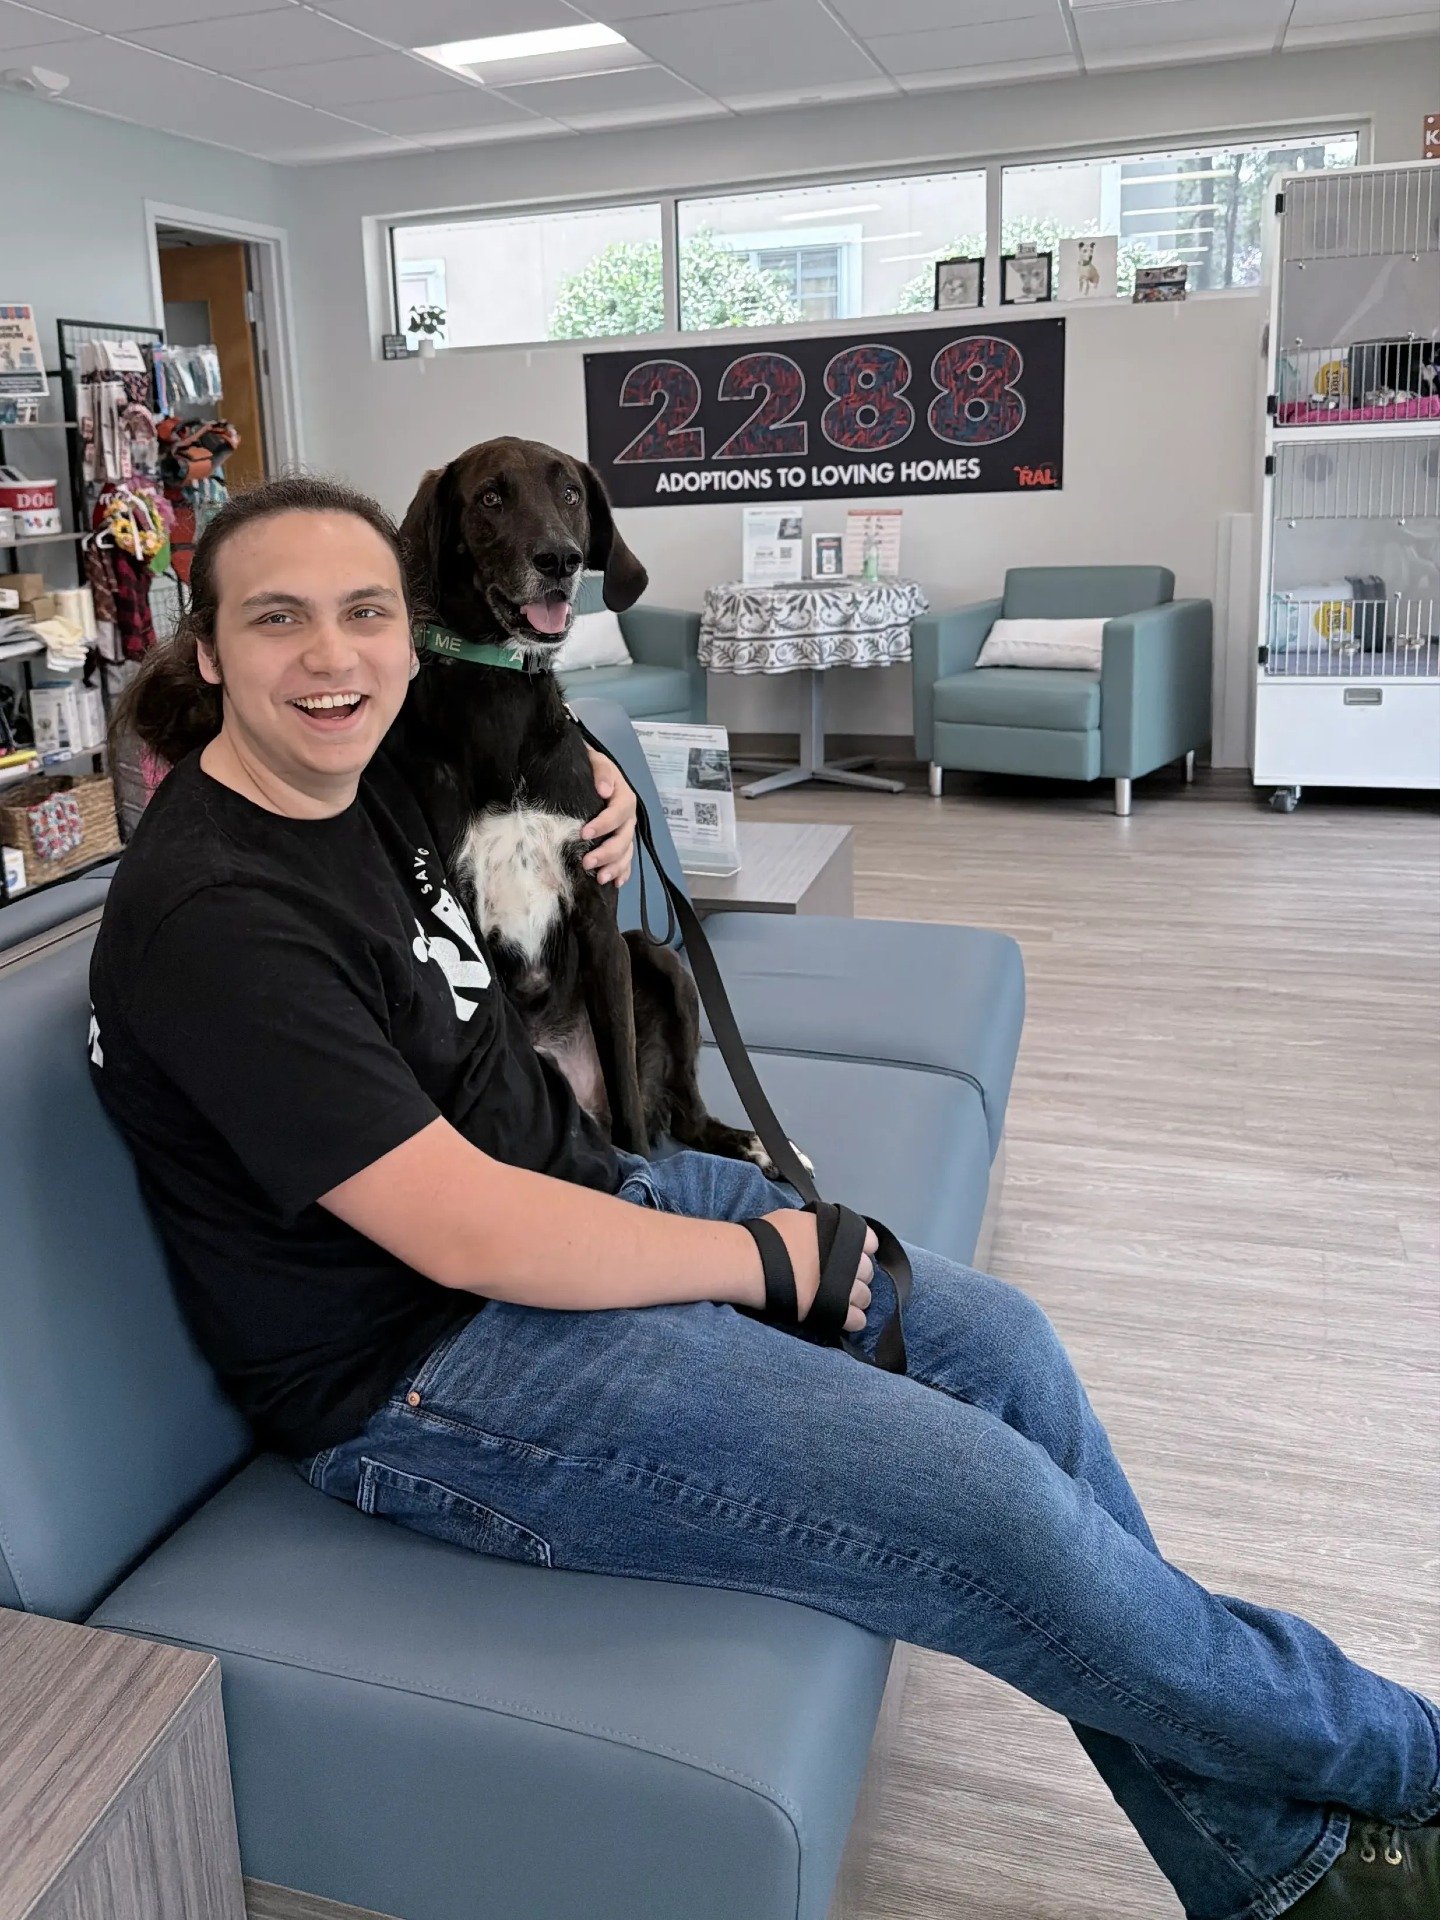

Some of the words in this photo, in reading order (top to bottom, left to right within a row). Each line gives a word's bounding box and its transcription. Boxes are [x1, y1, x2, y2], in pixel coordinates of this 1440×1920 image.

[613, 335, 1026, 465] 2288
[655, 468, 772, 493] ADOPTIONS
[777, 467, 806, 488] TO
[811, 463, 895, 487] LOVING
[901, 458, 981, 482] HOMES
[16, 492, 54, 509] DOG
[435, 633, 462, 652] ME
